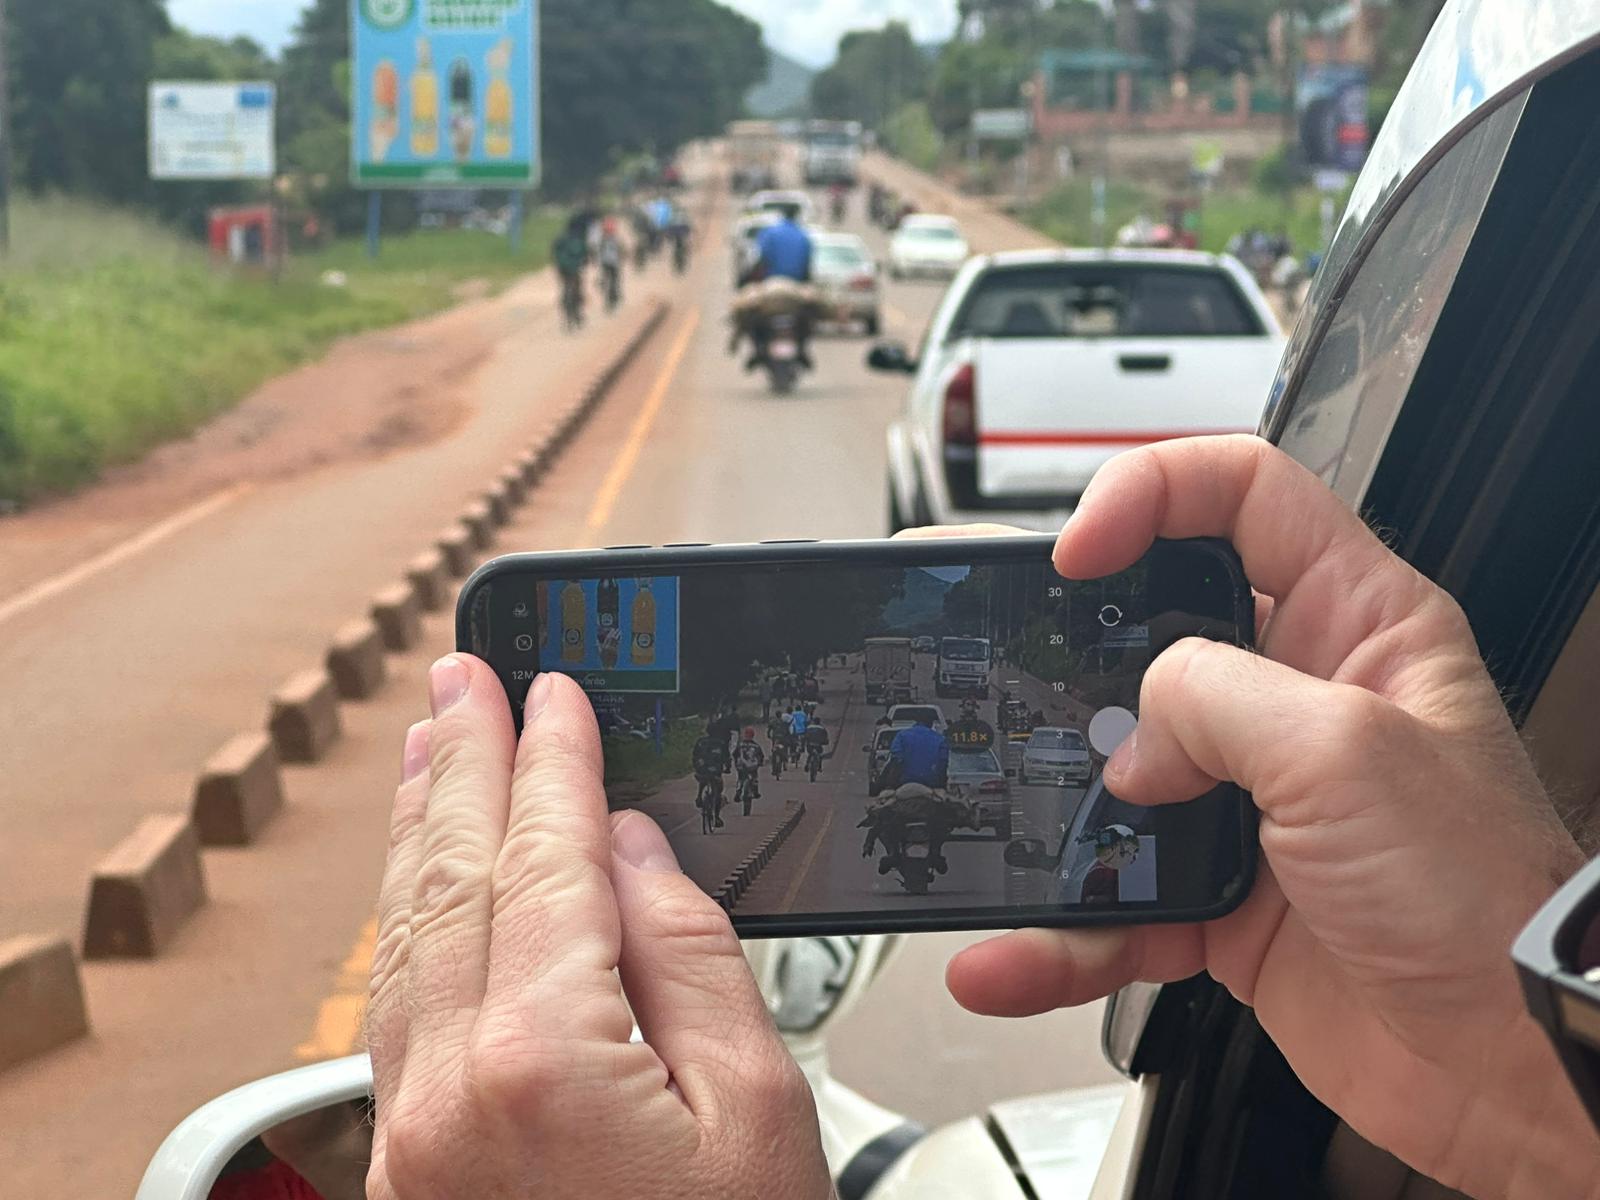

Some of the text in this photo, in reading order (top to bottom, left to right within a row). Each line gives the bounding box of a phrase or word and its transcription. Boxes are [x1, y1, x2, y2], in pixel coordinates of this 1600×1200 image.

[1048, 587, 1063, 597] 30
[1049, 634, 1064, 645] 20
[511, 670, 534, 681] 12M
[1052, 681, 1065, 692] 10
[1056, 729, 1063, 739] 3
[1057, 776, 1065, 786] 2
